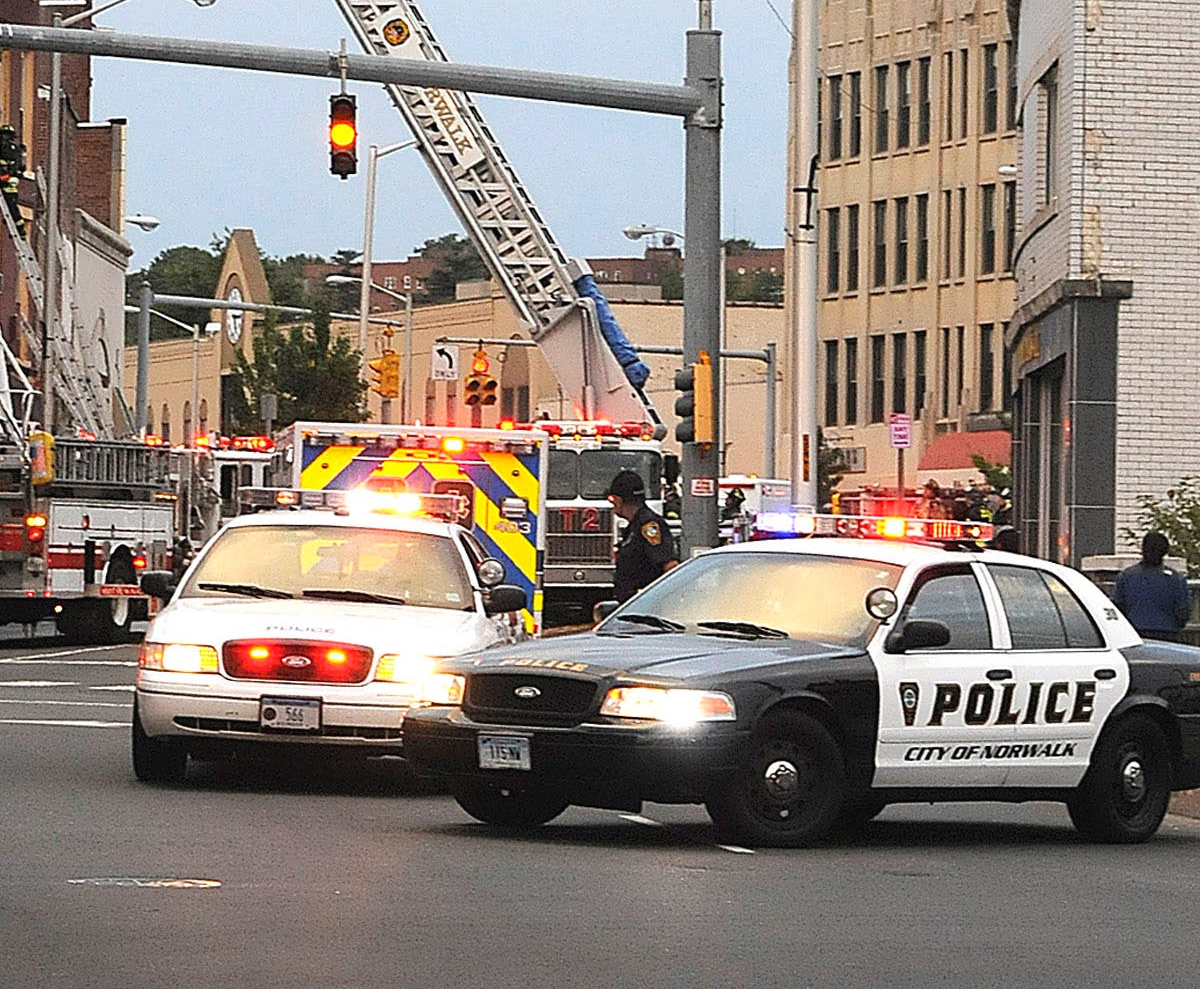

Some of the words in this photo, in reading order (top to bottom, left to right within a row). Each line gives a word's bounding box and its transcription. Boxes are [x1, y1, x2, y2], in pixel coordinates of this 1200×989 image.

[500, 658, 588, 672] POLICE
[927, 681, 1096, 727] POLICE
[904, 747, 950, 762] CITY
[951, 746, 980, 761] OF
[980, 742, 1078, 760] NORWALK
